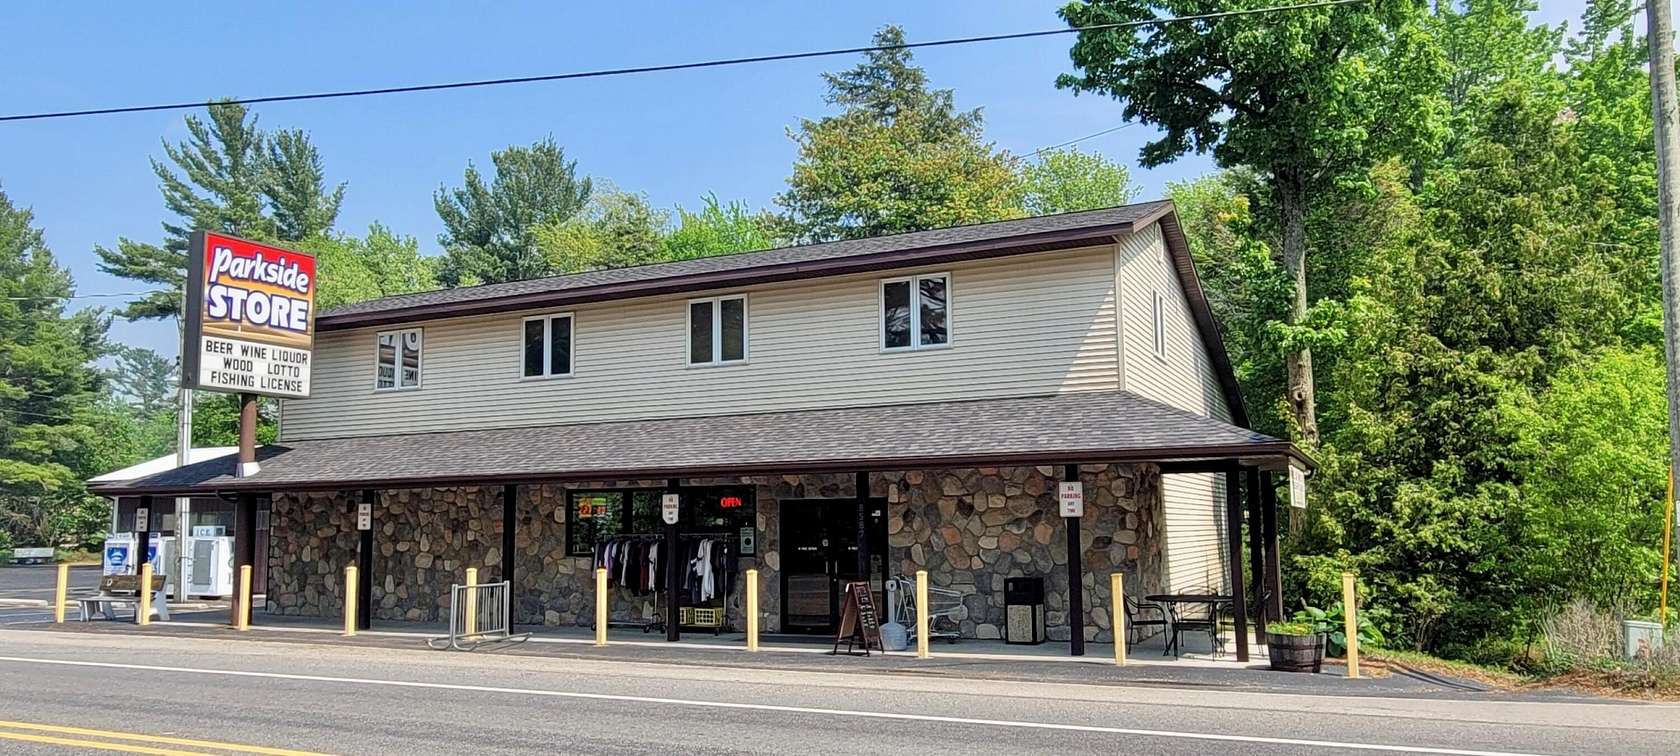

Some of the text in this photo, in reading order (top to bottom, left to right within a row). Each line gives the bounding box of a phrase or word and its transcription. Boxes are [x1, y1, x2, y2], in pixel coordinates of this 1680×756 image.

[209, 284, 308, 331] STORE
[205, 340, 308, 365] BEER WINE LIQUOR
[223, 358, 300, 378] WOOD LOTTO
[210, 371, 303, 392] FISHING LICENSE
[720, 497, 742, 508] OPEN
[196, 528, 211, 536] ICE
